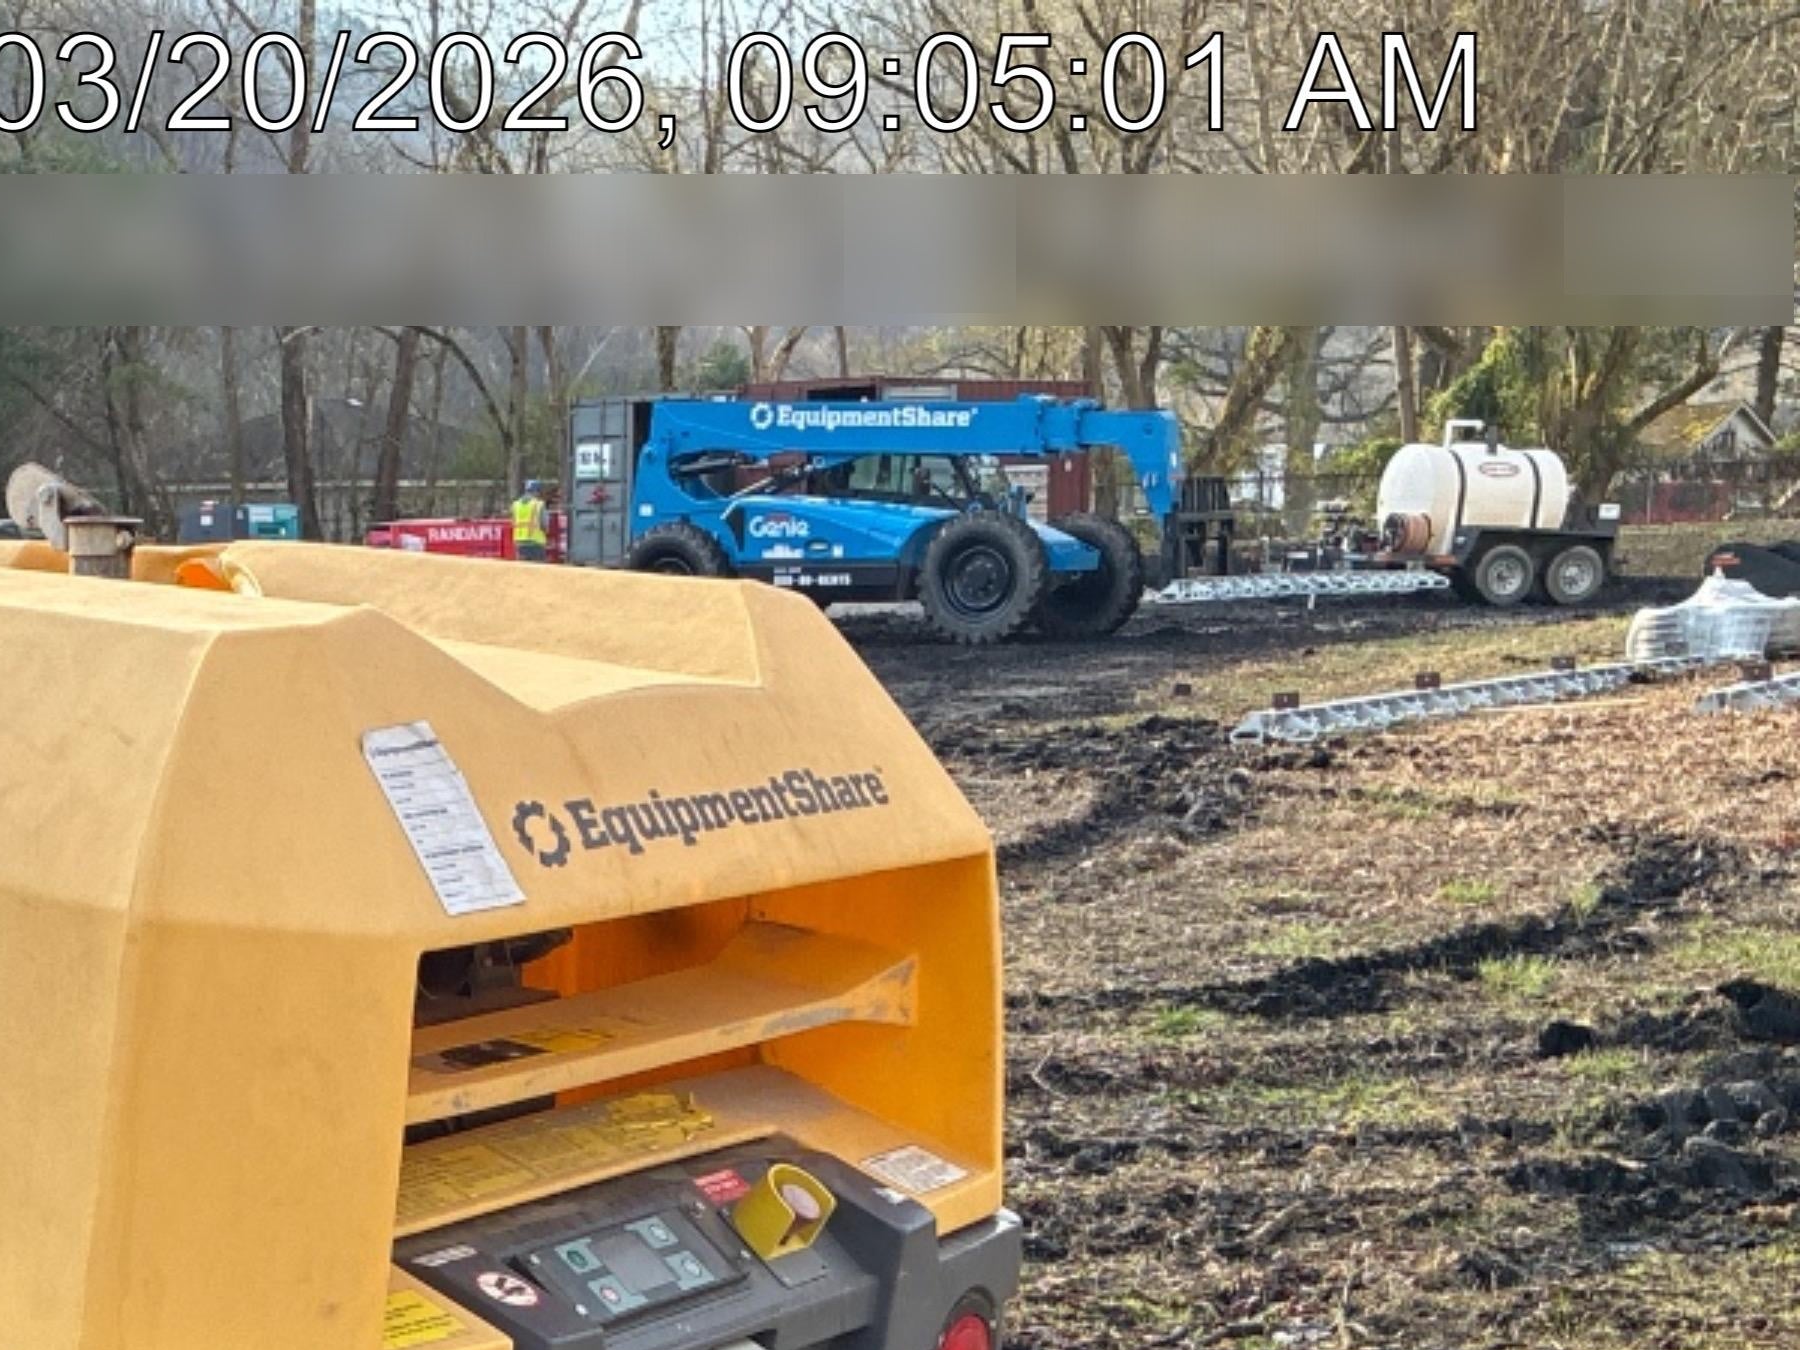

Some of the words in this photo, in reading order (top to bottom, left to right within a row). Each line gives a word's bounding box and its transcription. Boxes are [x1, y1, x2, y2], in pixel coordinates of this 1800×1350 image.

[776, 404, 971, 431] EquipmentShare
[748, 514, 810, 538] Genie
[563, 767, 890, 855] EquipmentShare
